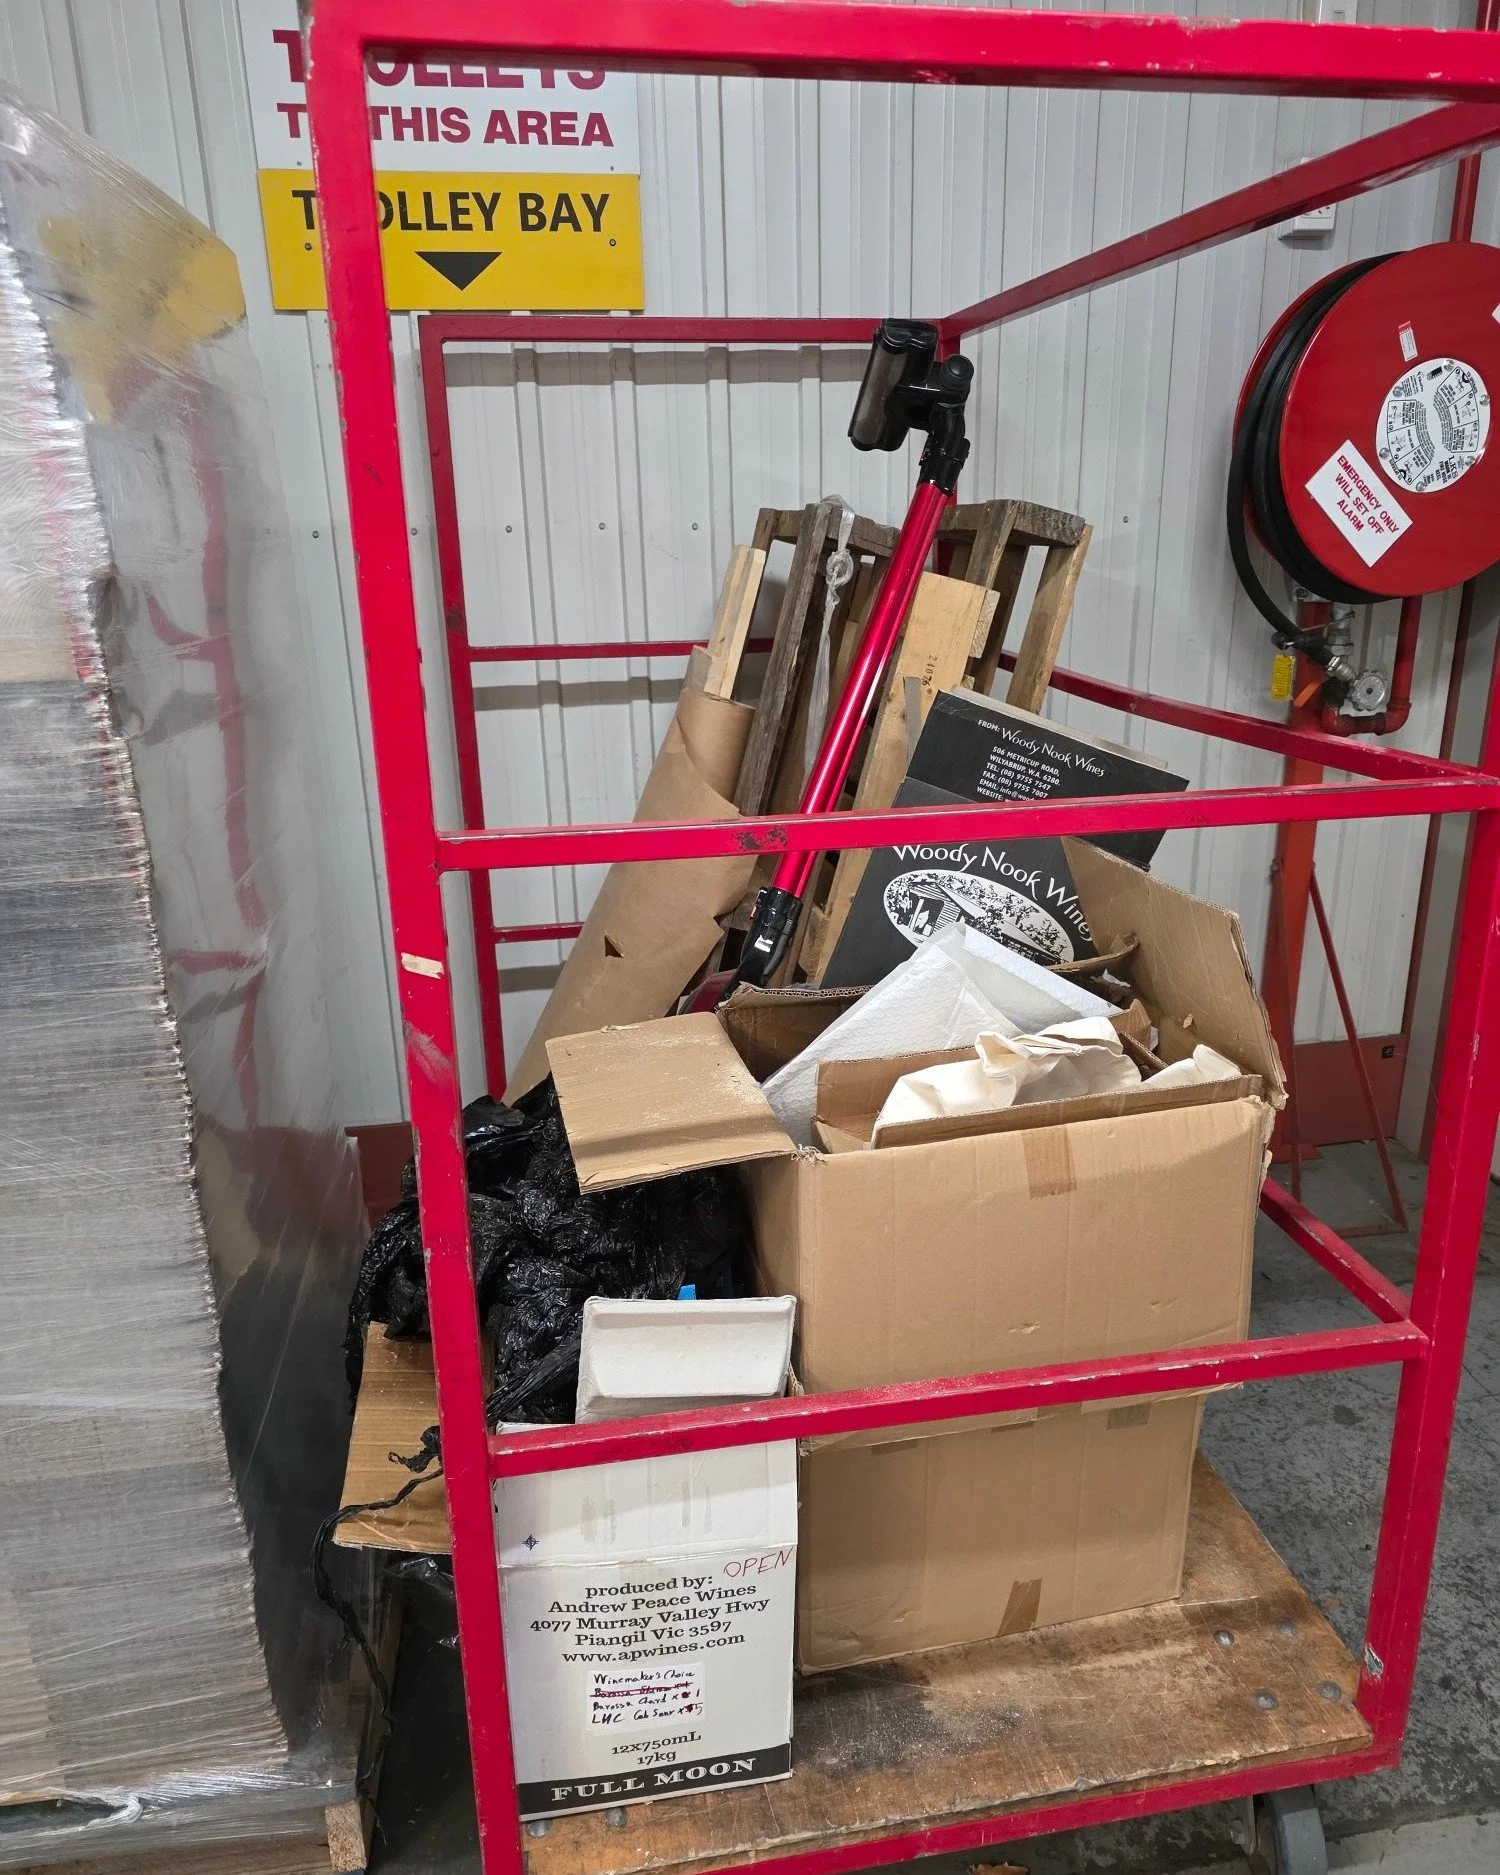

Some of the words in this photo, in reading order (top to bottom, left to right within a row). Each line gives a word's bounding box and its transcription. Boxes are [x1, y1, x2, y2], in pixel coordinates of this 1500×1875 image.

[273, 29, 606, 90] TOLL
[277, 102, 308, 139] T
[370, 105, 471, 144] THIS
[483, 109, 615, 148] AREA
[292, 189, 501, 232] TOLLEY
[518, 192, 610, 232] BAY
[1335, 473, 1354, 498] WILL
[1352, 496, 1370, 516] SET
[1367, 515, 1385, 535] OFF
[1337, 454, 1382, 510] EMERGENCY
[1379, 510, 1400, 534] ONLY
[1336, 499, 1364, 532] ALARM
[977, 719, 1000, 733] FROM:
[1002, 727, 1040, 755] Woody
[1041, 742, 1072, 769] Nook
[1075, 754, 1106, 777] Wines
[992, 746, 1005, 756] 506
[1006, 751, 1040, 767] METRICUP
[1040, 764, 1060, 777] ROAD,
[979, 778, 999, 791] EMAIL:
[982, 770, 997, 781] FAX:
[997, 776, 1012, 787] (08)
[1013, 782, 1030, 793] 9755
[1031, 788, 1049, 799] 7007
[986, 762, 1000, 773] TEL:
[1000, 768, 1015, 779] (08)
[1016, 774, 1033, 785] 9755
[1034, 780, 1052, 791] 7547
[990, 754, 1026, 774] WILYABRUP,
[1028, 768, 1042, 779] W.A.
[1042, 774, 1061, 786] 6280.
[977, 786, 1004, 802] WEBSITE:
[892, 844, 978, 872] Woody
[981, 846, 1043, 901] Nook
[723, 1546, 794, 1578] OPEN
[548, 1601, 627, 1613] Andrew
[631, 1596, 690, 1611] Peace
[695, 1585, 757, 1602] Wines
[585, 1578, 678, 1599] produced
[681, 1575, 713, 1590] by:
[530, 1620, 571, 1632] 4077
[576, 1616, 653, 1630] Murray
[657, 1607, 722, 1623] Valley
[725, 1598, 771, 1614] Hwy
[562, 1634, 746, 1662] www.apwines.com
[574, 1630, 647, 1648] Piangil
[650, 1627, 685, 1640] Vic
[688, 1620, 732, 1638] 3597
[593, 1670, 661, 1685] Winemaker's
[664, 1669, 695, 1680] Choice
[593, 1701, 634, 1711] Barossa
[633, 1709, 649, 1720] Cab
[637, 1750, 677, 1766] 17kg
[551, 1776, 645, 1801] FULL
[653, 1758, 757, 1786] MOON
